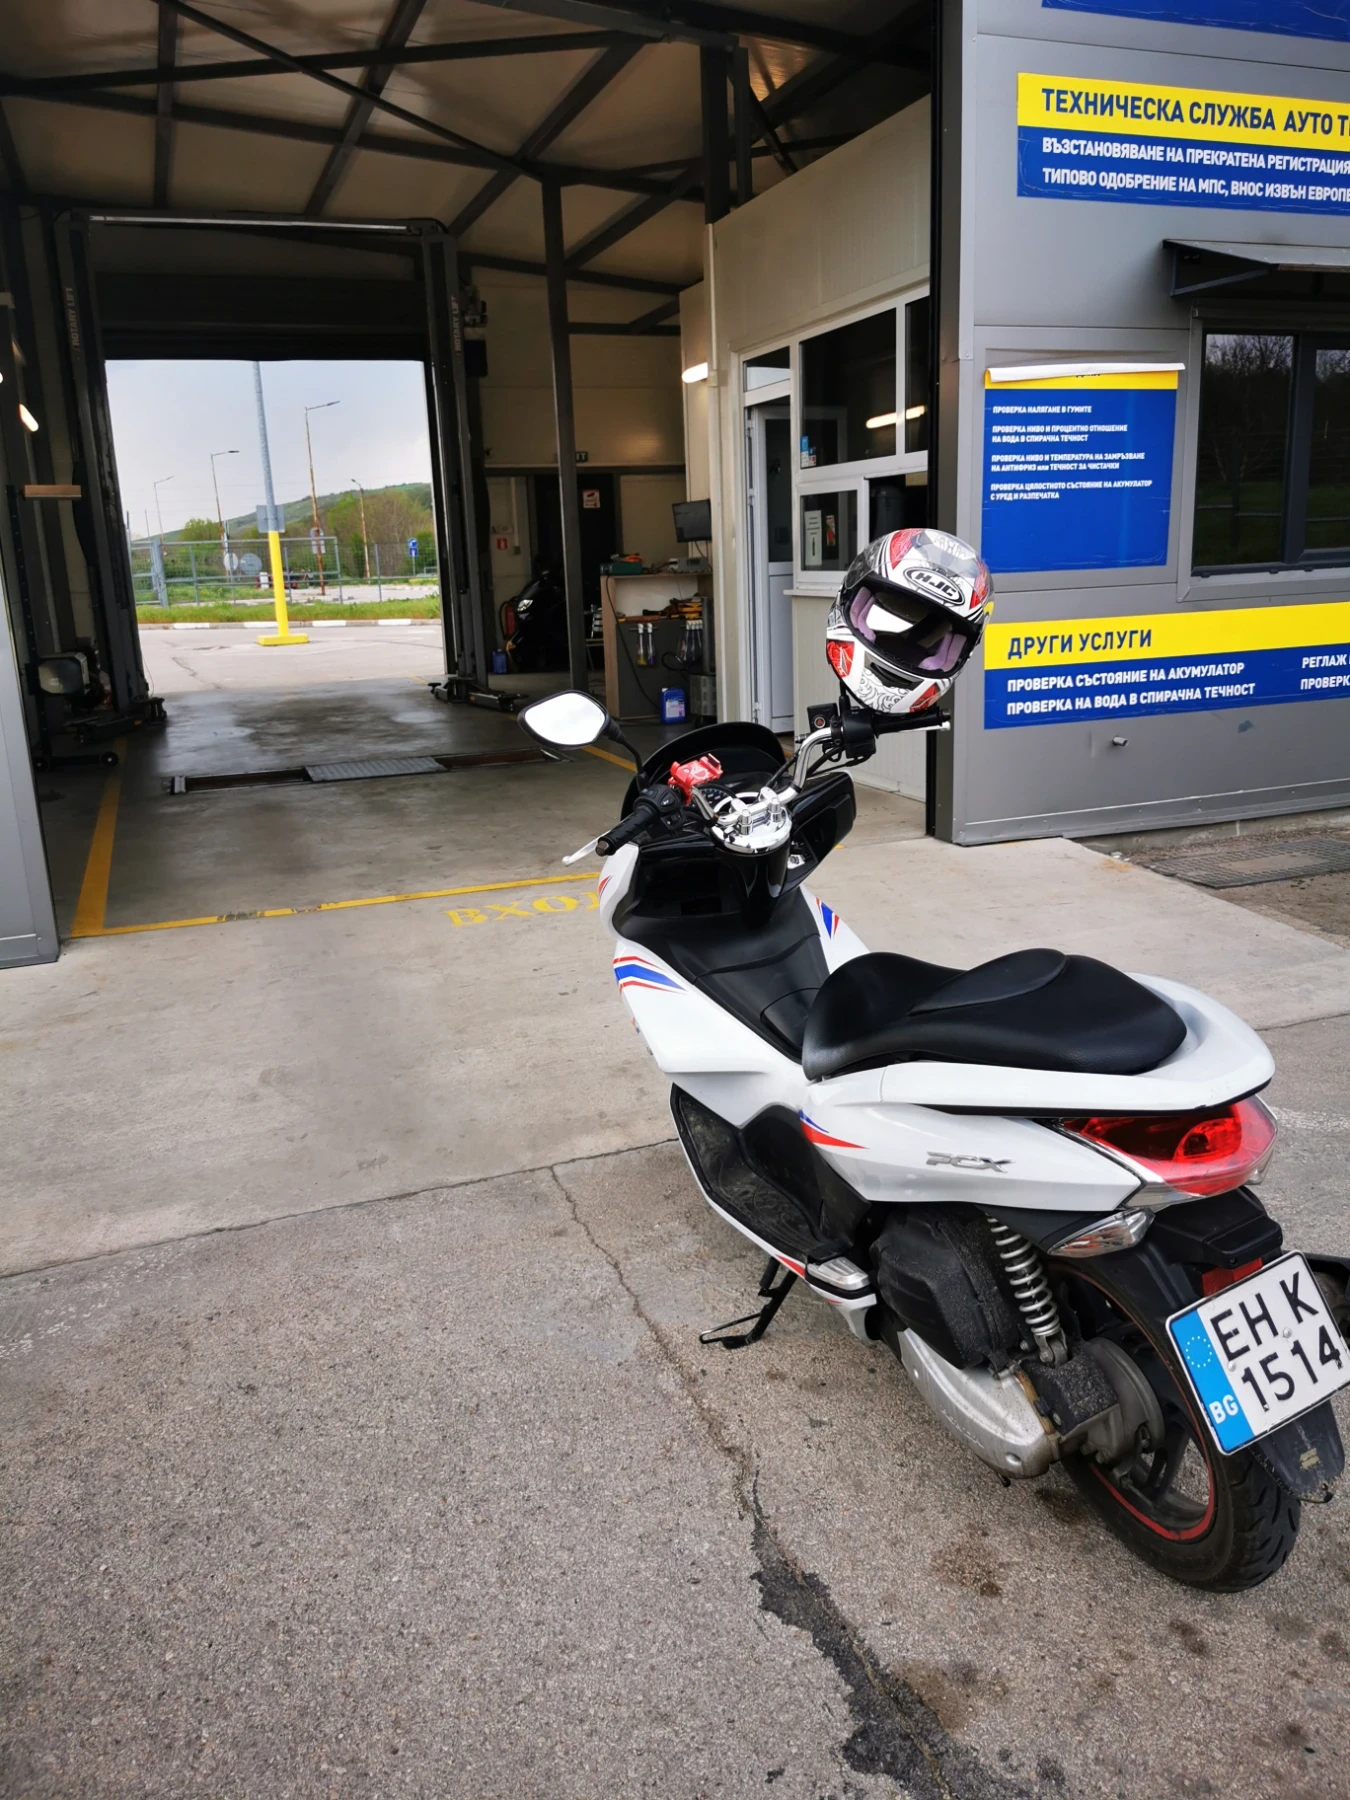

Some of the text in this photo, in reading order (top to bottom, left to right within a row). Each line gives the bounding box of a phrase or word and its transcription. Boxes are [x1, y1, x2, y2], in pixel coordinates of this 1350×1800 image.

[1042, 88, 1184, 123] ТЕХНИЧЕСКА
[1189, 101, 1276, 131] СЛУЖБА
[1283, 110, 1333, 135] АУТО
[1042, 137, 1164, 162] ВЪЗСТАНОВЯВАНЕ
[1166, 147, 1184, 163] НА
[1186, 148, 1266, 169] ПРЕКРАТЕНА
[1042, 168, 1097, 186] ТИПОВО
[1098, 172, 1177, 191] ОДОБРЕНИЕ
[1178, 177, 1197, 193] НА
[1198, 178, 1229, 197] МПС,
[1230, 181, 1264, 198] ВНОС
[1265, 183, 1306, 200] ИЗВЪН
[993, 405, 1092, 414] ПРОВЕРКА НАЛЯГАНЕ В ГУМИТЕ
[992, 425, 1026, 433] ПРОВЕРКА
[1027, 425, 1045, 433] НИВО
[1051, 425, 1089, 433] ПРОЦЕНТНО
[1089, 424, 1128, 432] ОТНОШЕНИЕ
[992, 435, 1001, 443] НА
[1002, 435, 1020, 444] ВОДА
[1020, 435, 1025, 443] В
[1060, 434, 1089, 442] ТЕЧНОСТ
[991, 454, 1025, 462] ПРОВЕРКА
[1050, 453, 1094, 461] ТЕМПЕРАТУРА
[1104, 452, 1145, 460] ЗАМРЪЗВАНЕ
[991, 464, 1001, 472] НА
[1001, 464, 1037, 472] АНТИФРИЗ
[1049, 463, 1078, 471] ТЕЧНОСТ
[1087, 462, 1120, 470] ЧИСТАЧКИ
[990, 483, 1024, 491] ПРОВЕРКА
[1025, 482, 1066, 491] ЦЯЛОСТНОТО
[1066, 481, 1103, 489] СЪСТОЯНИЕ
[1113, 480, 1153, 488] АКУМУЛАТОР
[995, 493, 1013, 501] УРЕД
[1013, 492, 1019, 500] И
[1019, 491, 1060, 500] РАЗПЕЧАТКА
[914, 572, 957, 597] HJC
[1008, 629, 1152, 660] ДРУГИ УСЛУГИ
[1302, 654, 1348, 669] РЕГЛАЖ
[1007, 662, 1245, 692] ПРОВЕРКА СЪСТОЯНИЕ НА АКУМУЛАТОР
[1006, 683, 1256, 715] ПРОВЕРКА НА ВОДА В СПИРАЧНА ТЕЧНОСТ
[926, 1151, 1016, 1174] PCX
[1209, 1270, 1319, 1362] EH K
[1241, 1325, 1344, 1413] 1514
[1208, 1393, 1239, 1424] BG
